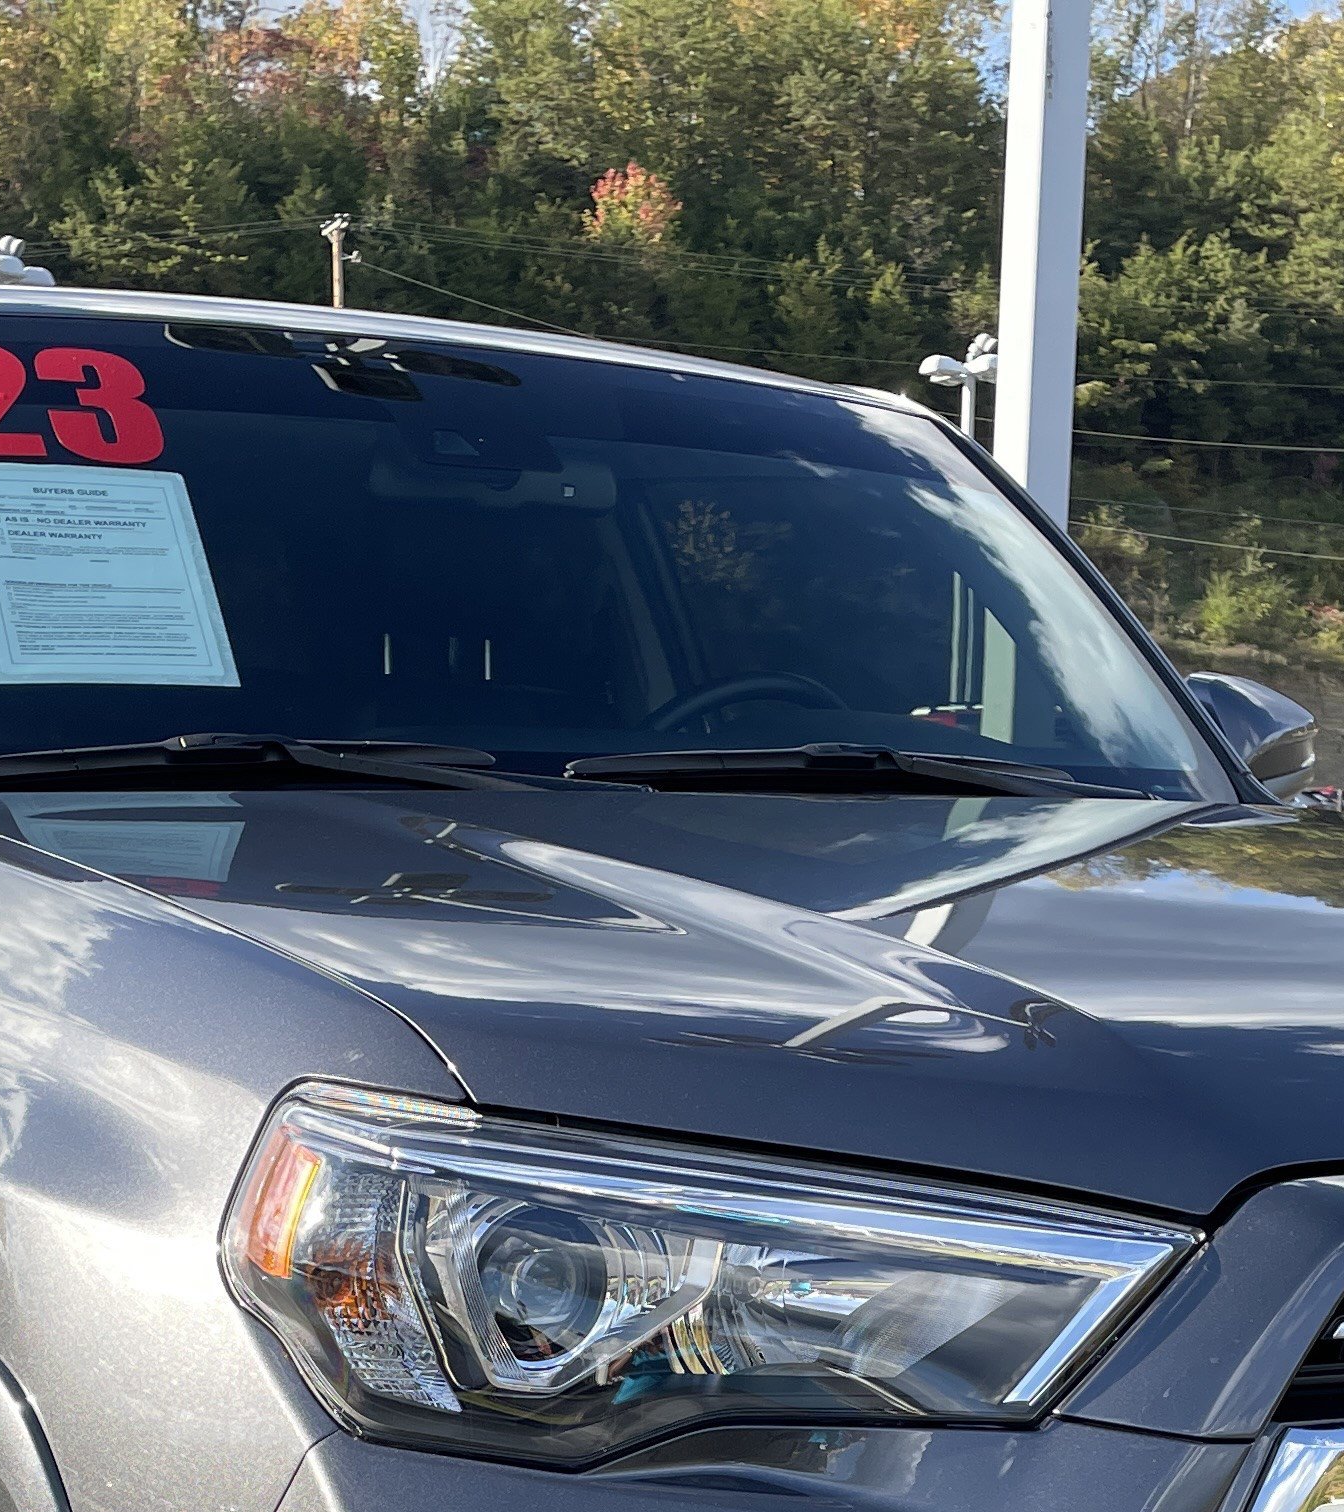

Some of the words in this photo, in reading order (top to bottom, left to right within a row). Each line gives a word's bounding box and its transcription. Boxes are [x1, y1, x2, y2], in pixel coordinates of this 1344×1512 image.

[32, 487, 75, 495] BUYERS
[76, 488, 108, 496] GUIDE
[53, 518, 92, 526] DEALER
[93, 520, 147, 528] WARRANTY
[7, 529, 47, 537] DEALER
[48, 531, 103, 540] WARRANTY
